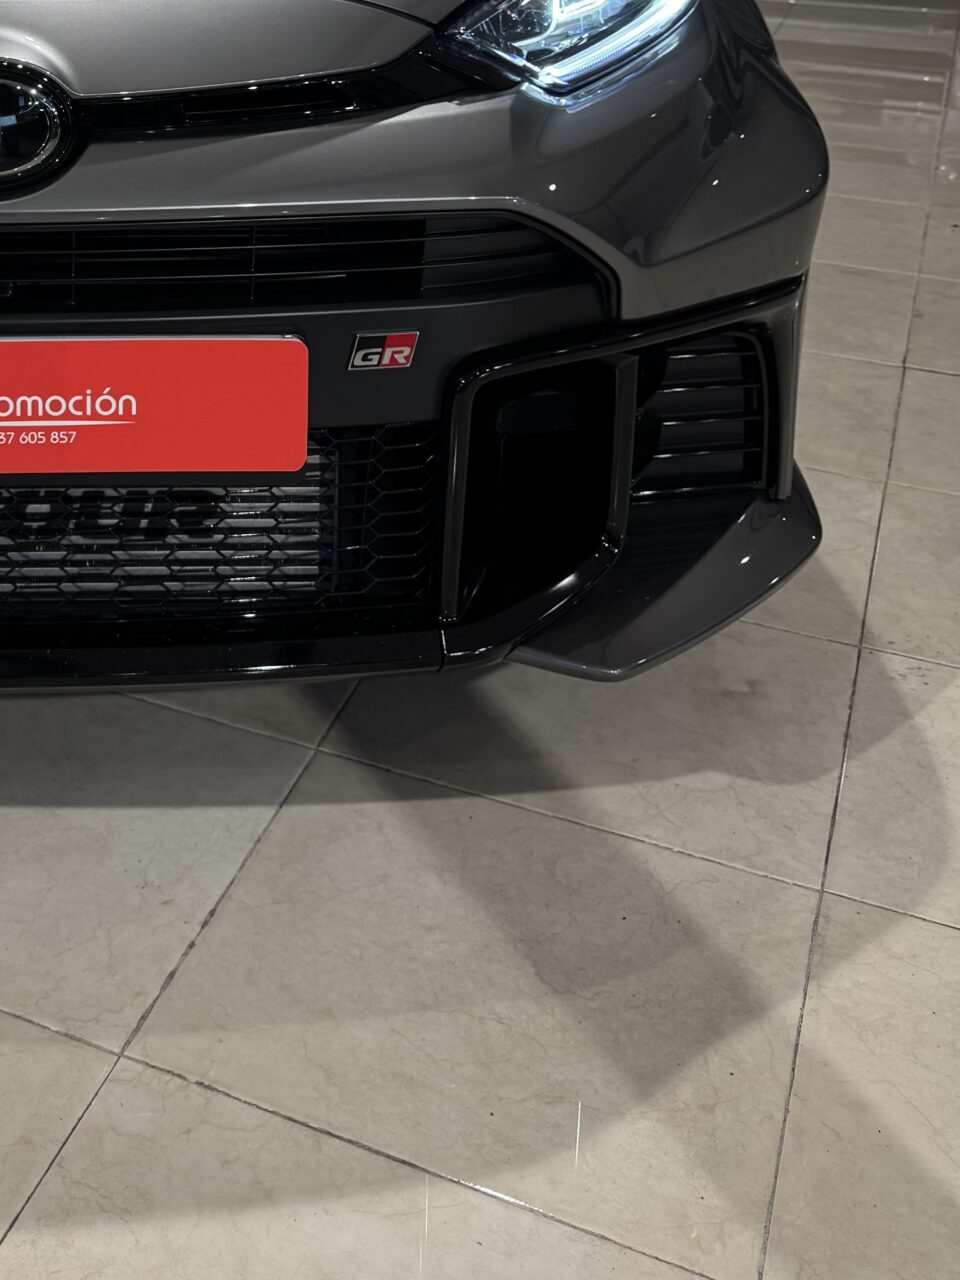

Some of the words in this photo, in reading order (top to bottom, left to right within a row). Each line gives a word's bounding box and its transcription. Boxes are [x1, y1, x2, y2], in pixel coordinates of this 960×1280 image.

[353, 346, 411, 366] GR
[18, 431, 46, 444] 605
[50, 431, 77, 444] 857
